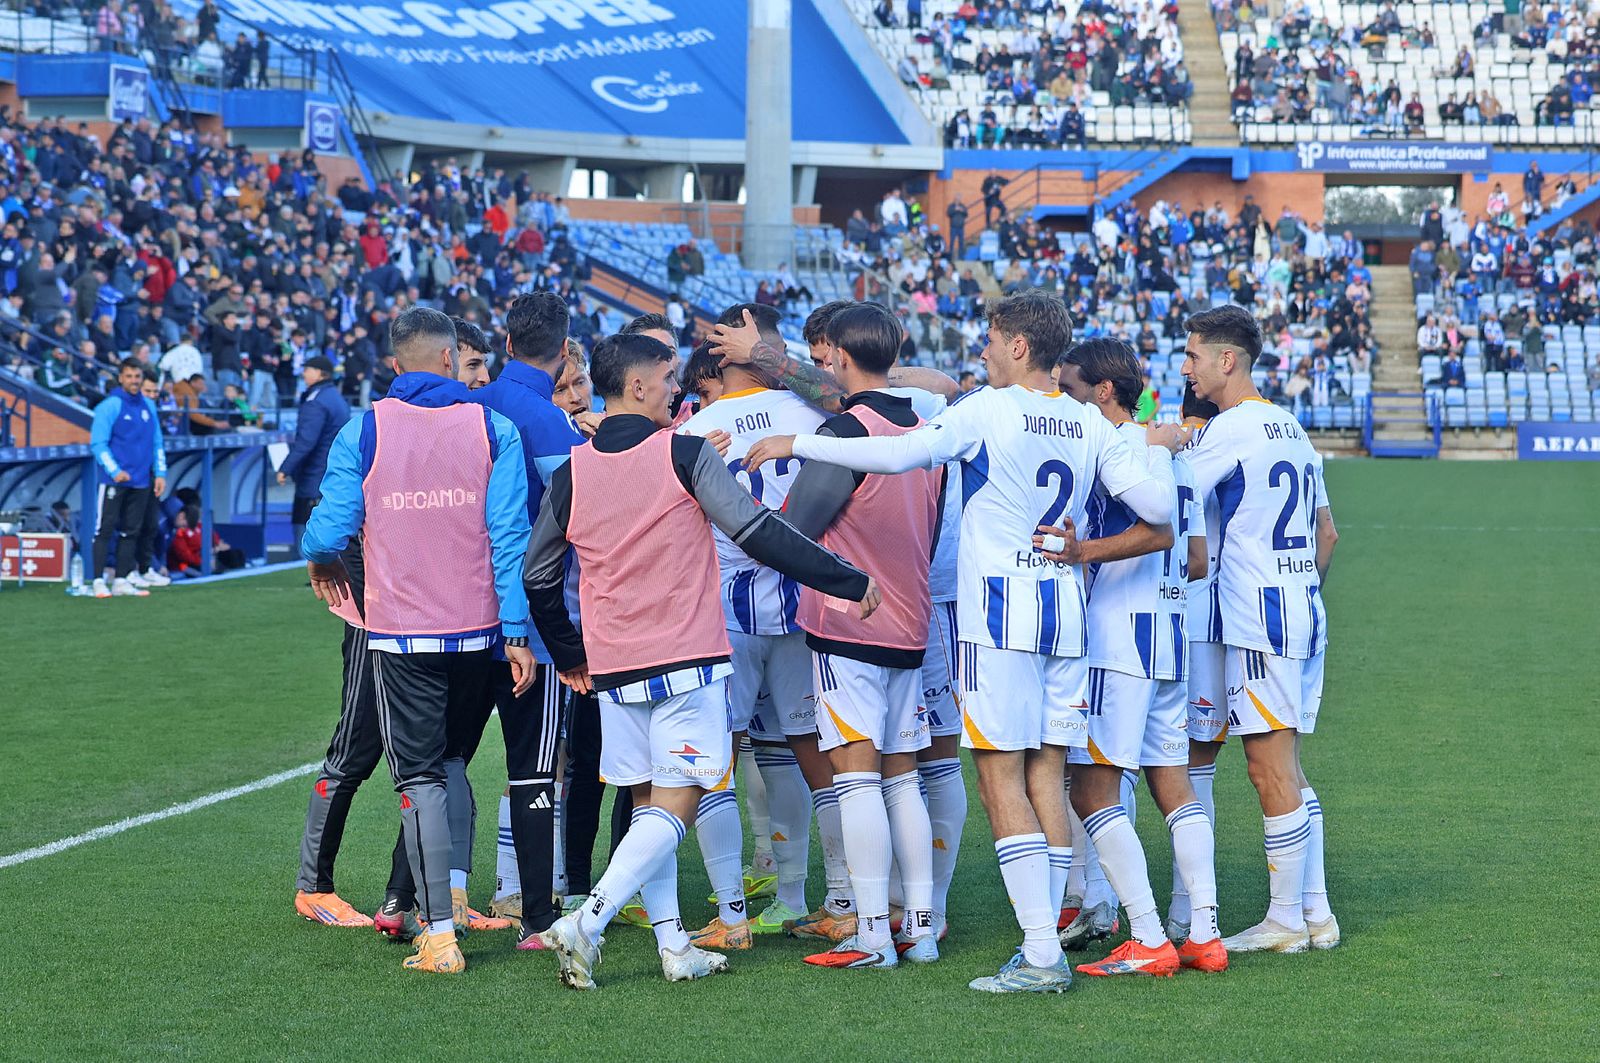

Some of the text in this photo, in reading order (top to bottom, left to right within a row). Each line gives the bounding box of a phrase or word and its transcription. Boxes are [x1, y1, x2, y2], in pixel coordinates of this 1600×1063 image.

[1408, 145, 1487, 160] Profesional
[735, 411, 772, 434] RONI
[1023, 414, 1083, 439] JUANCHO
[1263, 422, 1283, 440] DA
[391, 488, 466, 511] DECANO
[1032, 459, 1074, 553] 2
[1268, 460, 1317, 551] 20
[1277, 556, 1314, 575] Hue
[789, 710, 816, 720] GRUPO
[1050, 719, 1079, 730] GRUPO
[899, 729, 920, 739] GRUP
[656, 765, 725, 777] GRUPO INTERBUS
